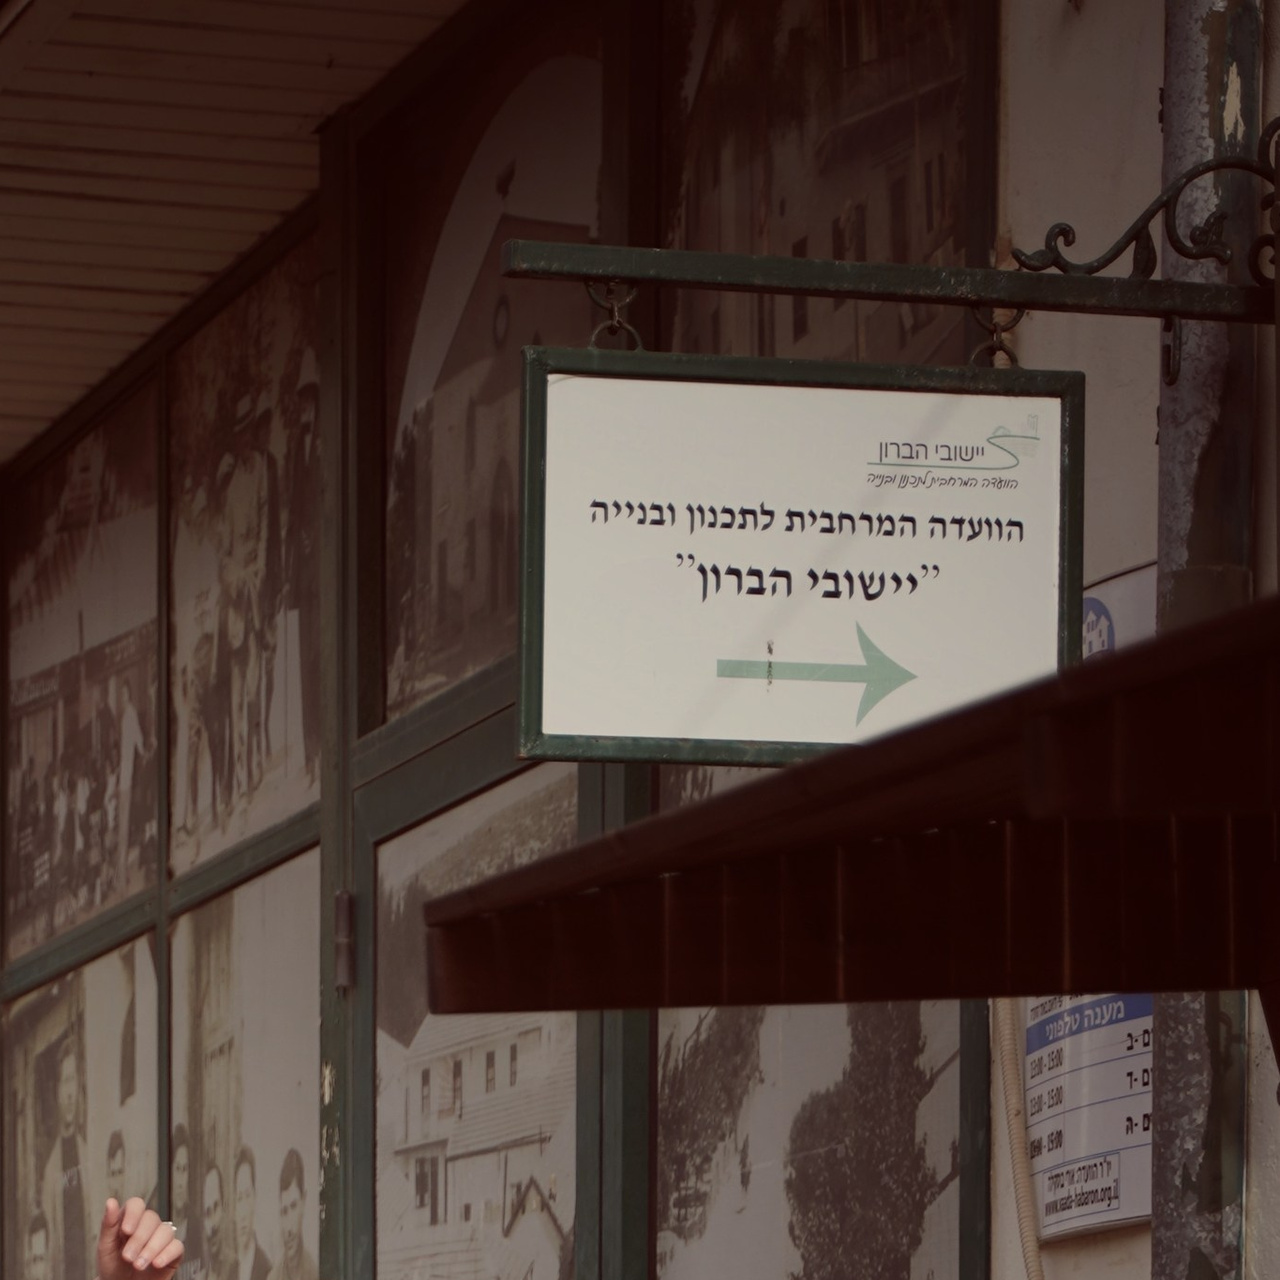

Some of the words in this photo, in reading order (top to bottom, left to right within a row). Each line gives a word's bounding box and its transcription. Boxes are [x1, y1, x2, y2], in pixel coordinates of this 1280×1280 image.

[879, 441, 928, 463] הברון
[935, 443, 985, 463] יישובי
[866, 472, 897, 488] ובנייה
[897, 470, 932, 489] לתכנון
[926, 473, 978, 489] המרחבית
[980, 476, 1019, 490] הוועדה
[589, 498, 677, 527] ובנייה
[685, 500, 776, 536] לתכנון
[784, 508, 918, 539] המרחבית
[927, 514, 1024, 544] הוועדה
[1045, 1011, 1081, 1041] טלפוני
[1083, 999, 1126, 1030] מענה
